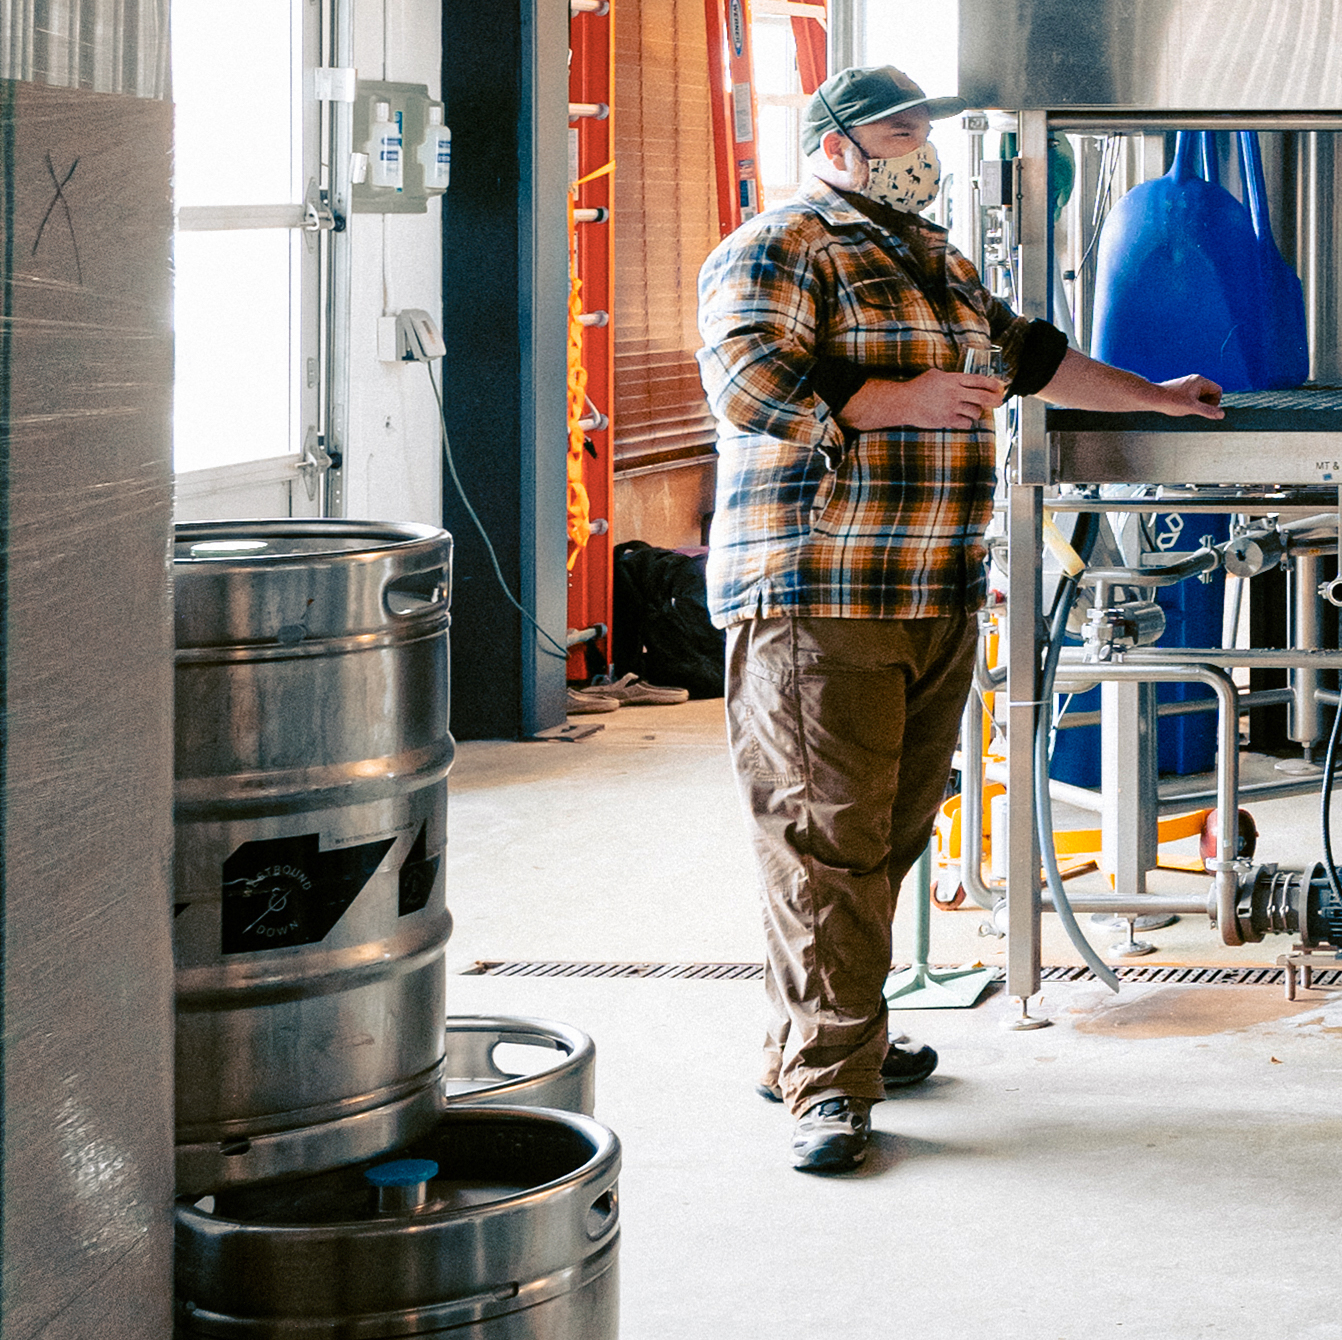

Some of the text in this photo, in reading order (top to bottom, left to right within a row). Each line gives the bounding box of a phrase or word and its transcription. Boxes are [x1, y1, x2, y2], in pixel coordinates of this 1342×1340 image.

[732, 3, 741, 45] WERNER
[1315, 461, 1331, 470] MT
[1332, 461, 1340, 471] &
[255, 920, 299, 937] DOWN
